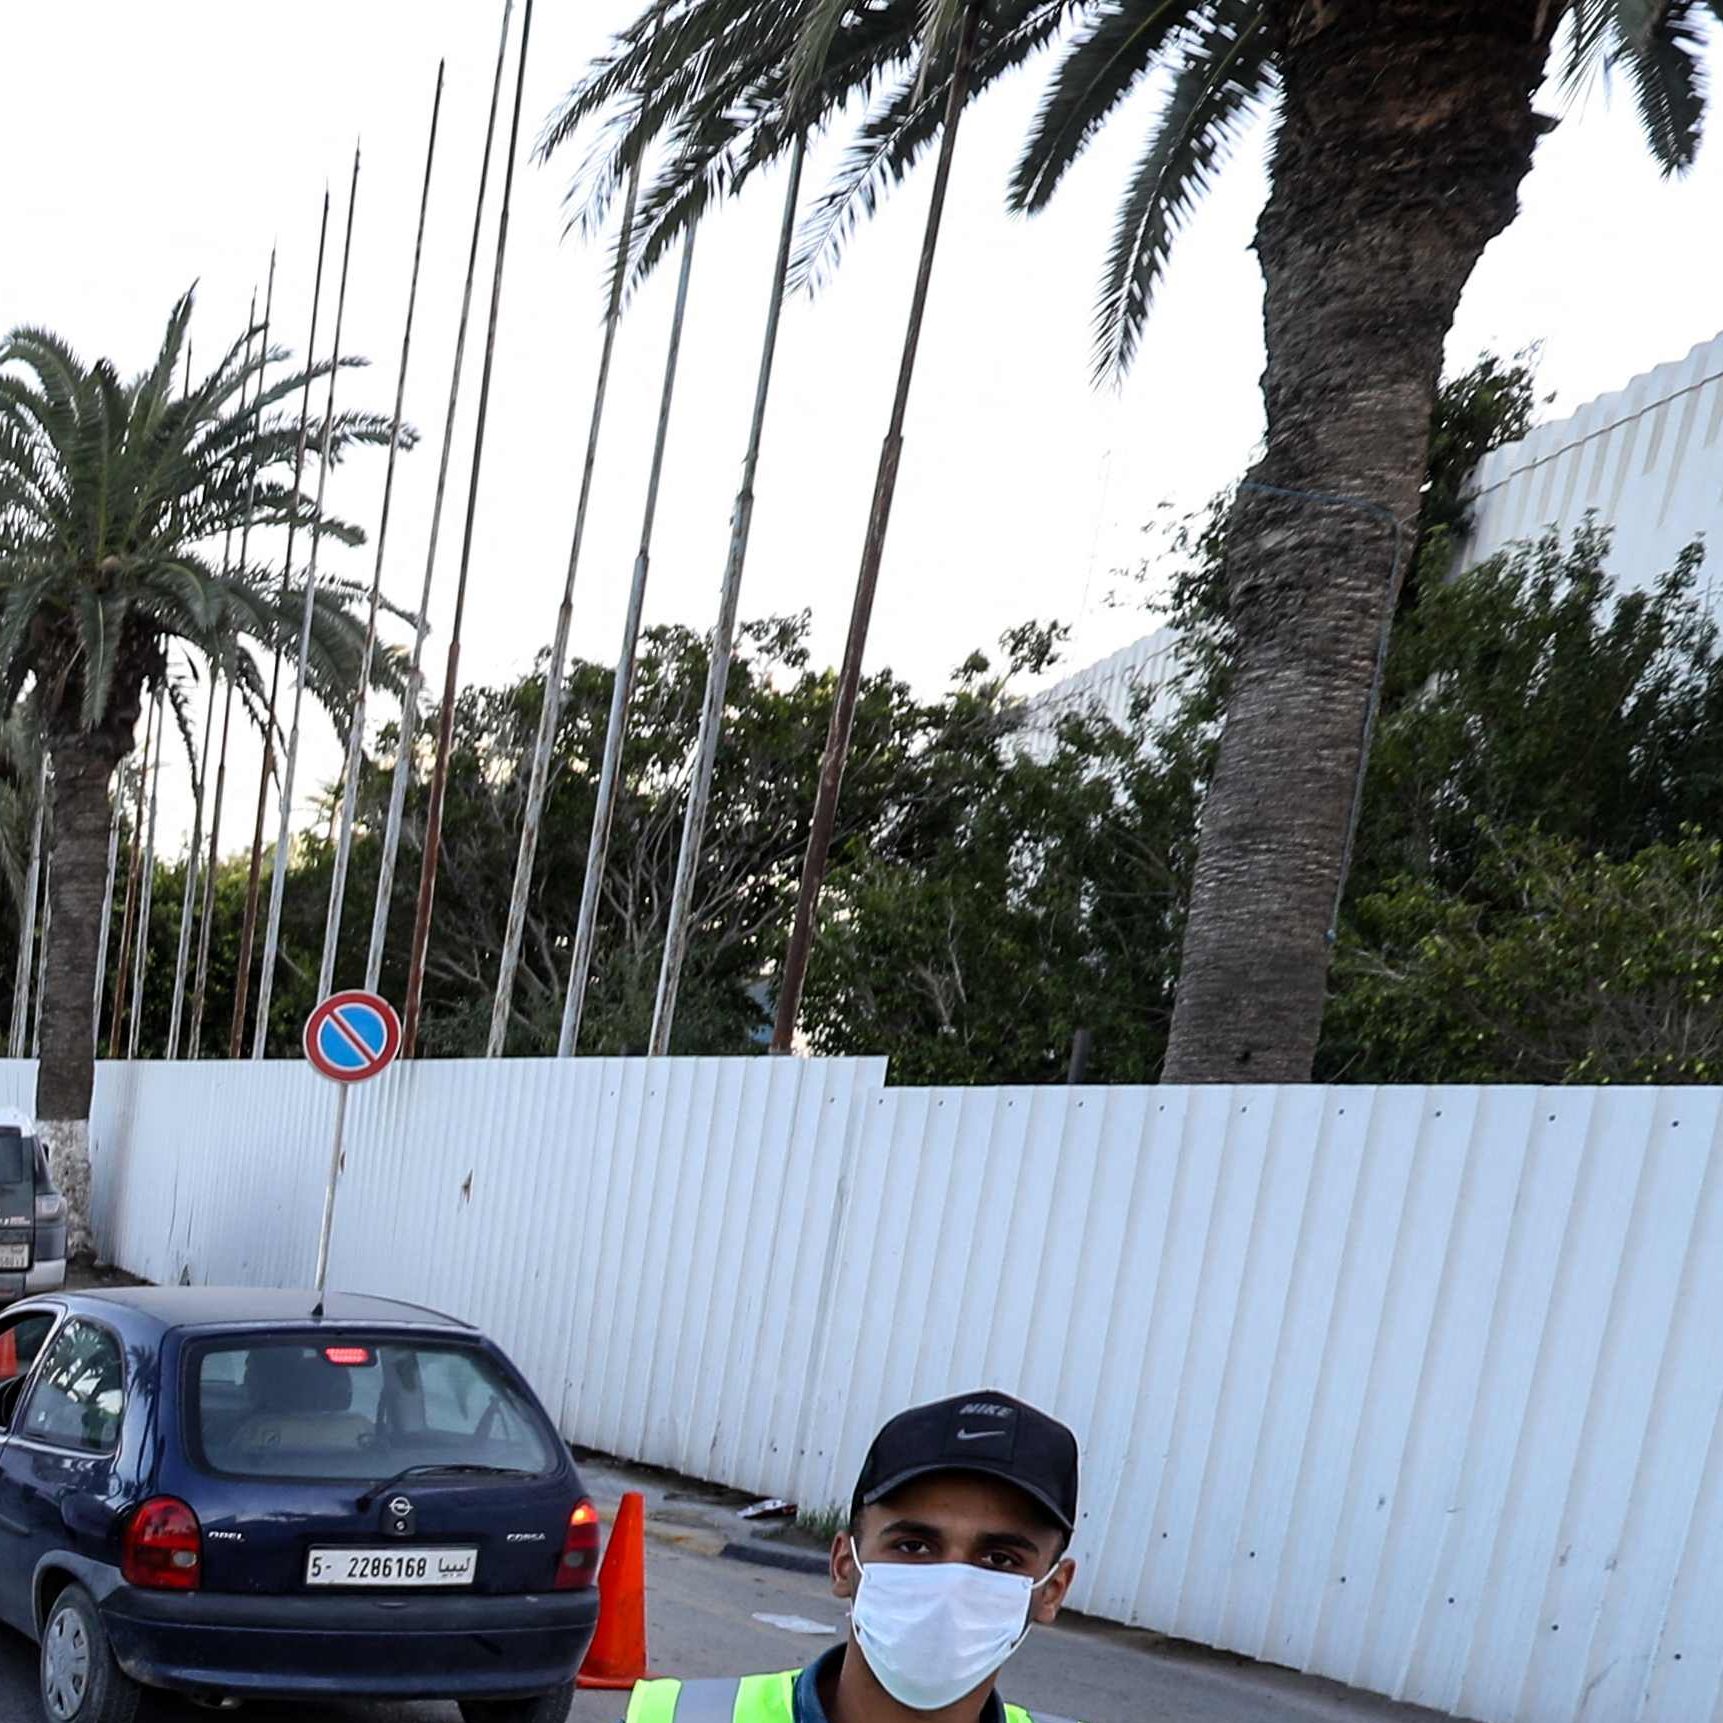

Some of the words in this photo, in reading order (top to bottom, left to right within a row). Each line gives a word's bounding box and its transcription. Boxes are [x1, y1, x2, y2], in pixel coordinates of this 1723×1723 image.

[959, 1403, 1014, 1418] NIKE
[346, 1556, 428, 1579] 2286168
[437, 1556, 472, 1577] ليبيا
